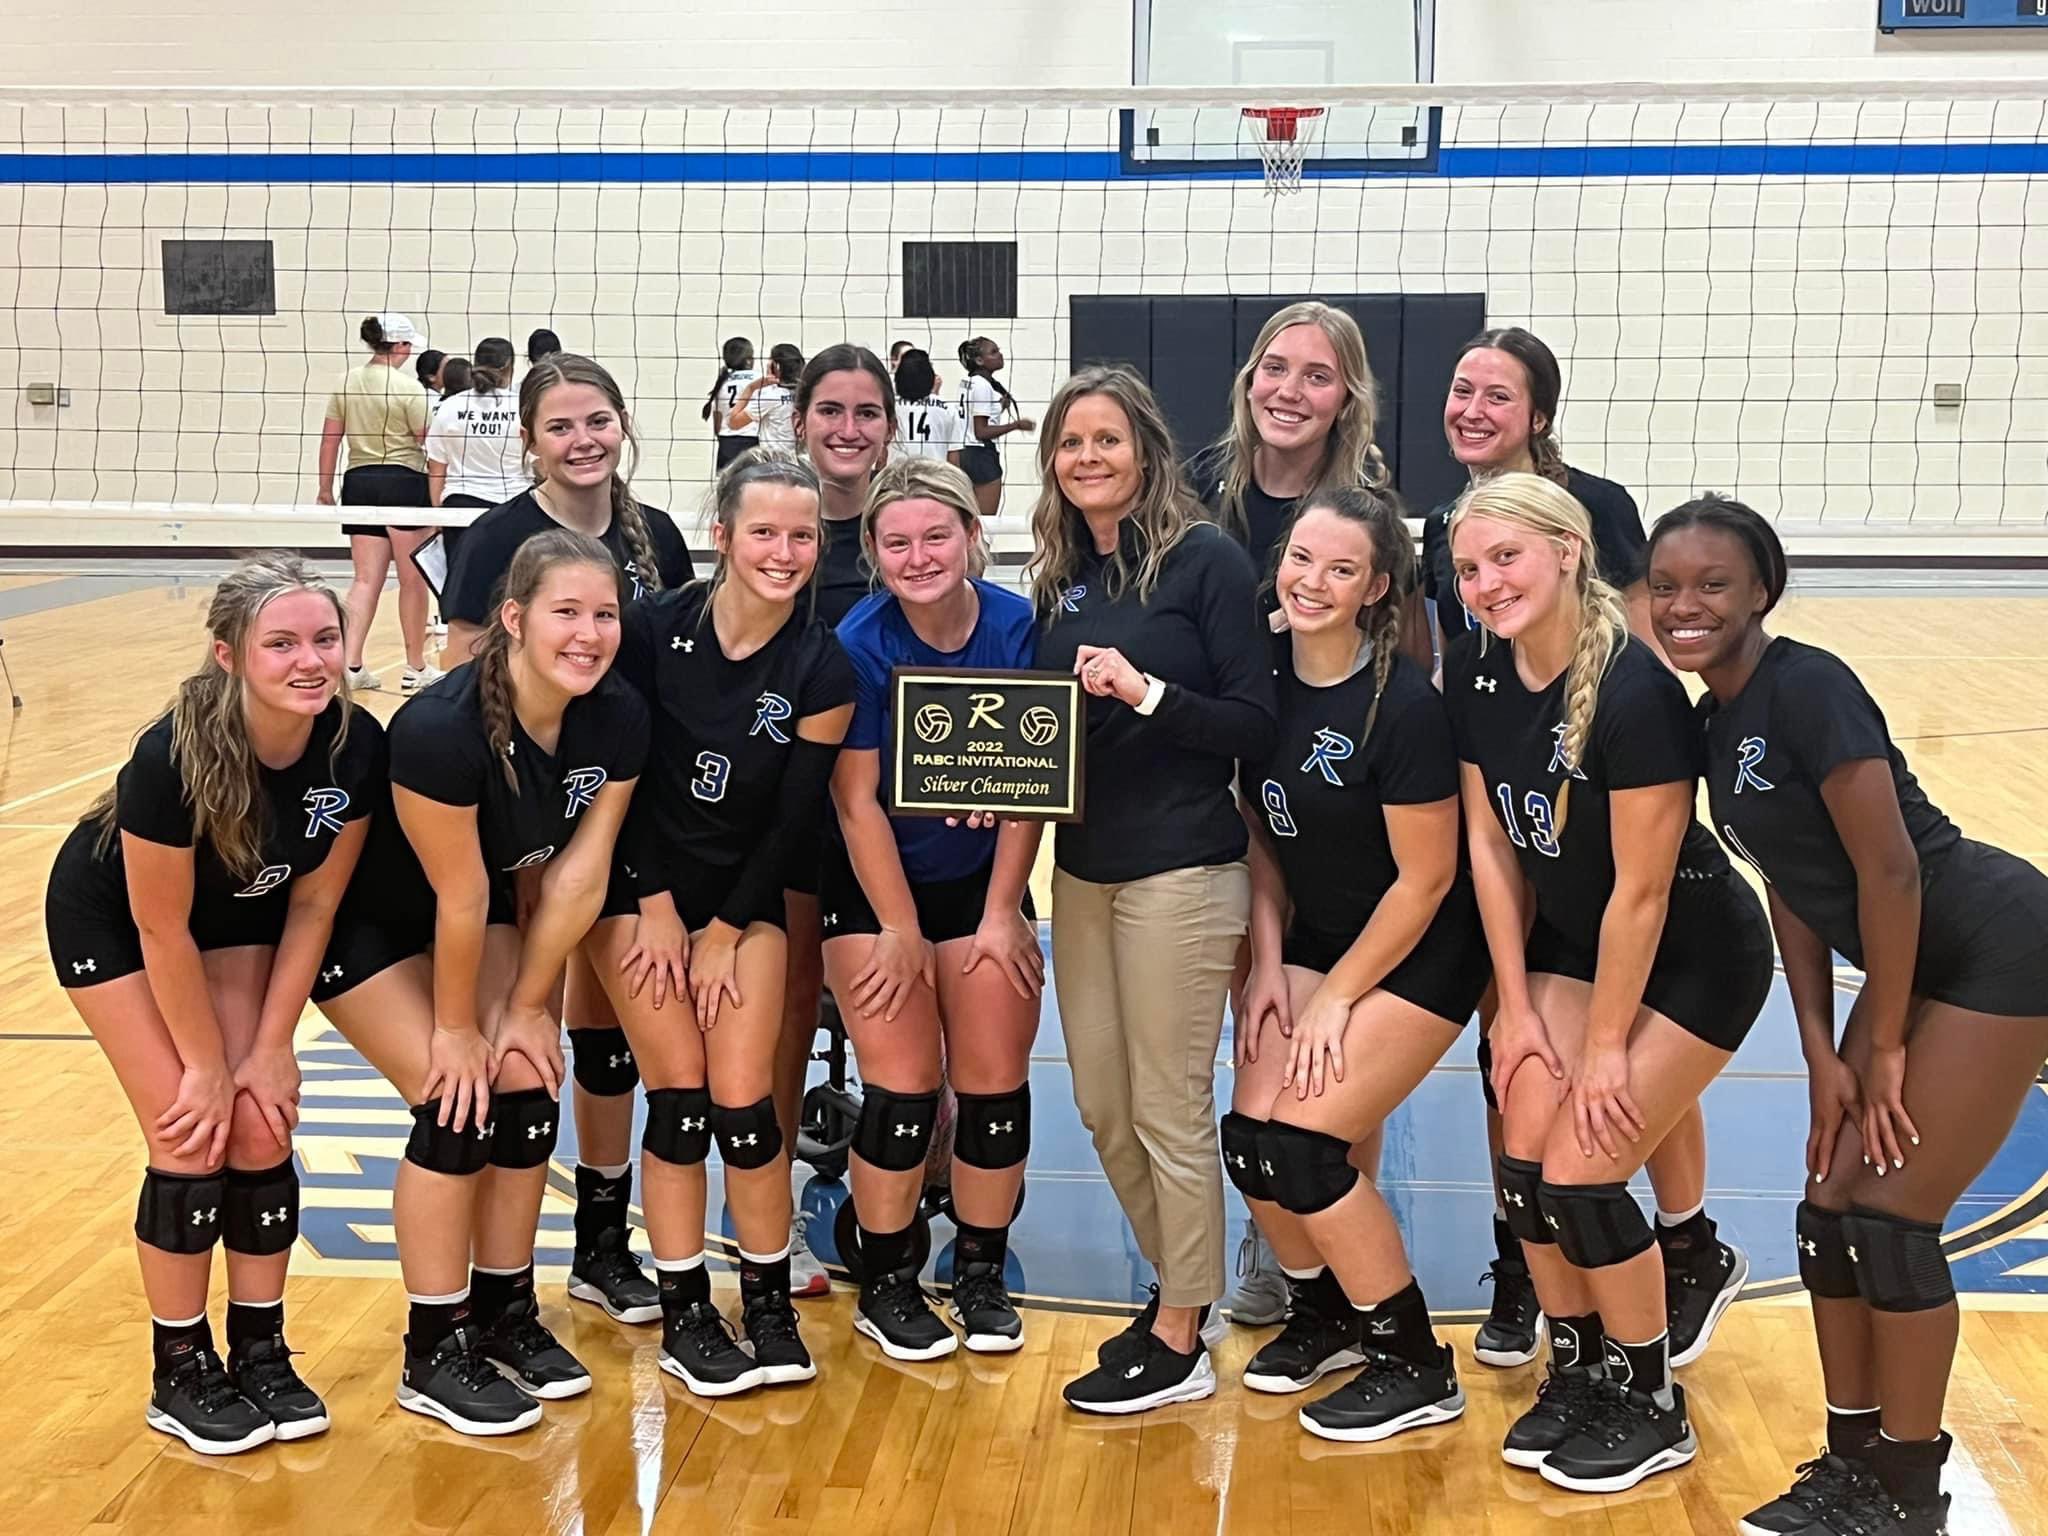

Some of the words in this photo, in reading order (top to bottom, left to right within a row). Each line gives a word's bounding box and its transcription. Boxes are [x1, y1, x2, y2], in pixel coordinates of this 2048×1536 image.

[457, 410, 475, 420] WE
[481, 411, 517, 421] WANT
[471, 423, 501, 435] YOU!
[909, 412, 931, 440] 14
[749, 690, 792, 743] R
[967, 693, 1005, 729] R
[913, 754, 954, 766] RABC
[957, 755, 1058, 769] INVITATIONAL
[966, 741, 1004, 753] 2022
[1300, 726, 1354, 786] R
[1734, 736, 1775, 794] R
[562, 766, 607, 818] R
[691, 751, 731, 803] 3
[920, 774, 968, 793] Silver
[971, 776, 1050, 799] Champion
[302, 786, 350, 838] R
[1262, 779, 1298, 837] 9
[1497, 783, 1560, 857] 13
